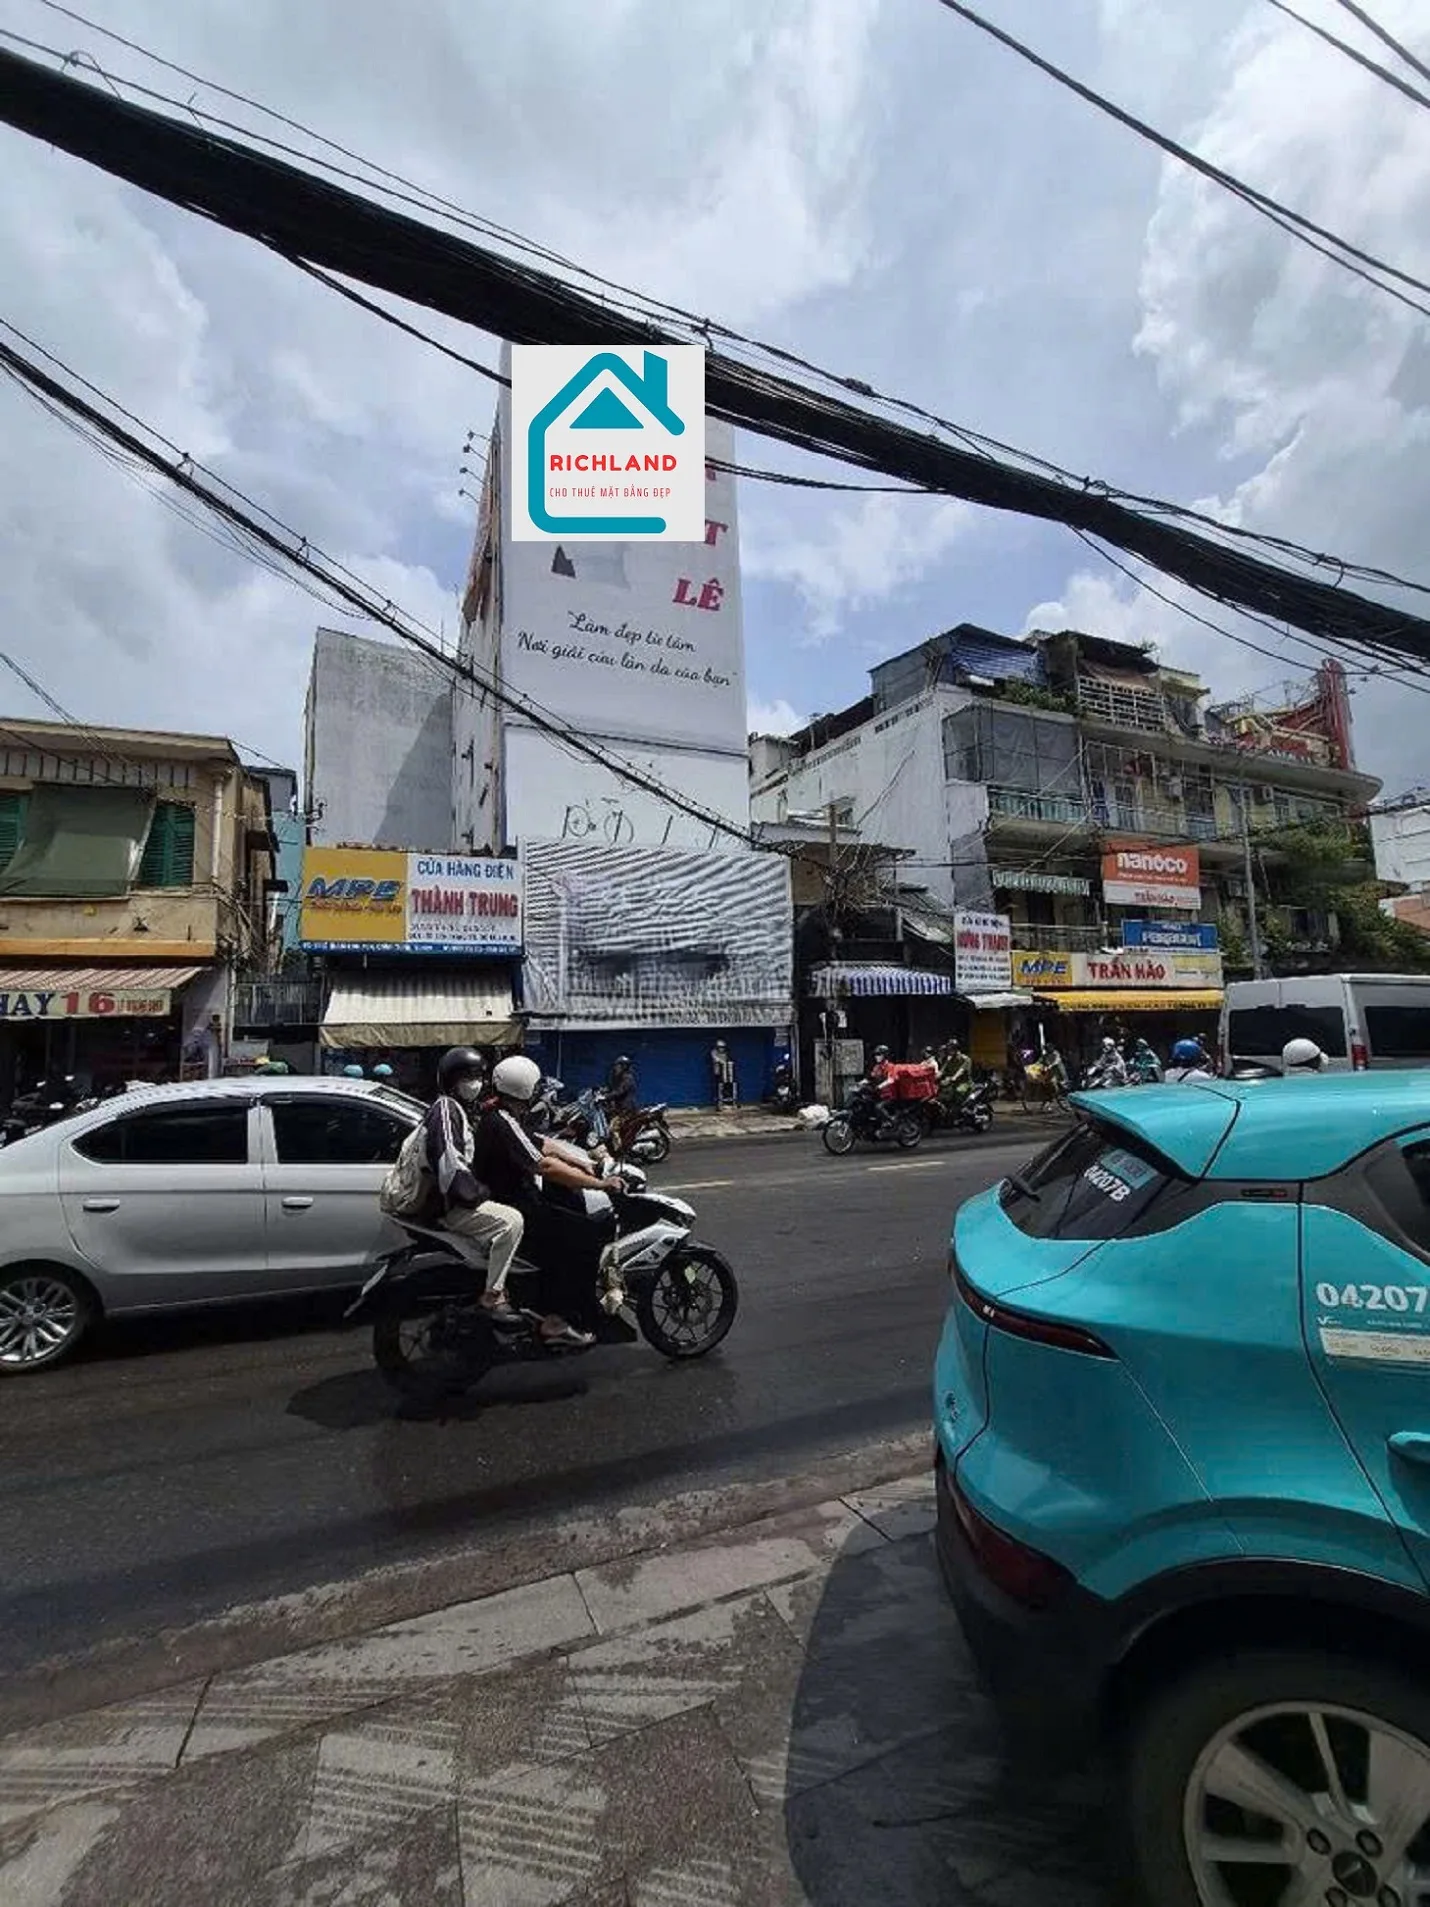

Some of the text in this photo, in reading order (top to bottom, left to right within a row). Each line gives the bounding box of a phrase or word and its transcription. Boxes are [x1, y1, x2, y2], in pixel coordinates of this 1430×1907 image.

[672, 577, 724, 611] LÊ
[447, 860, 480, 878] HÀNG
[306, 877, 401, 900] MPE
[411, 884, 464, 916] THÀNH
[469, 891, 518, 918] TRUNG
[1021, 958, 1068, 976] MPE
[60, 992, 115, 1015] 16
[1316, 1282, 1427, 1313] 04207
